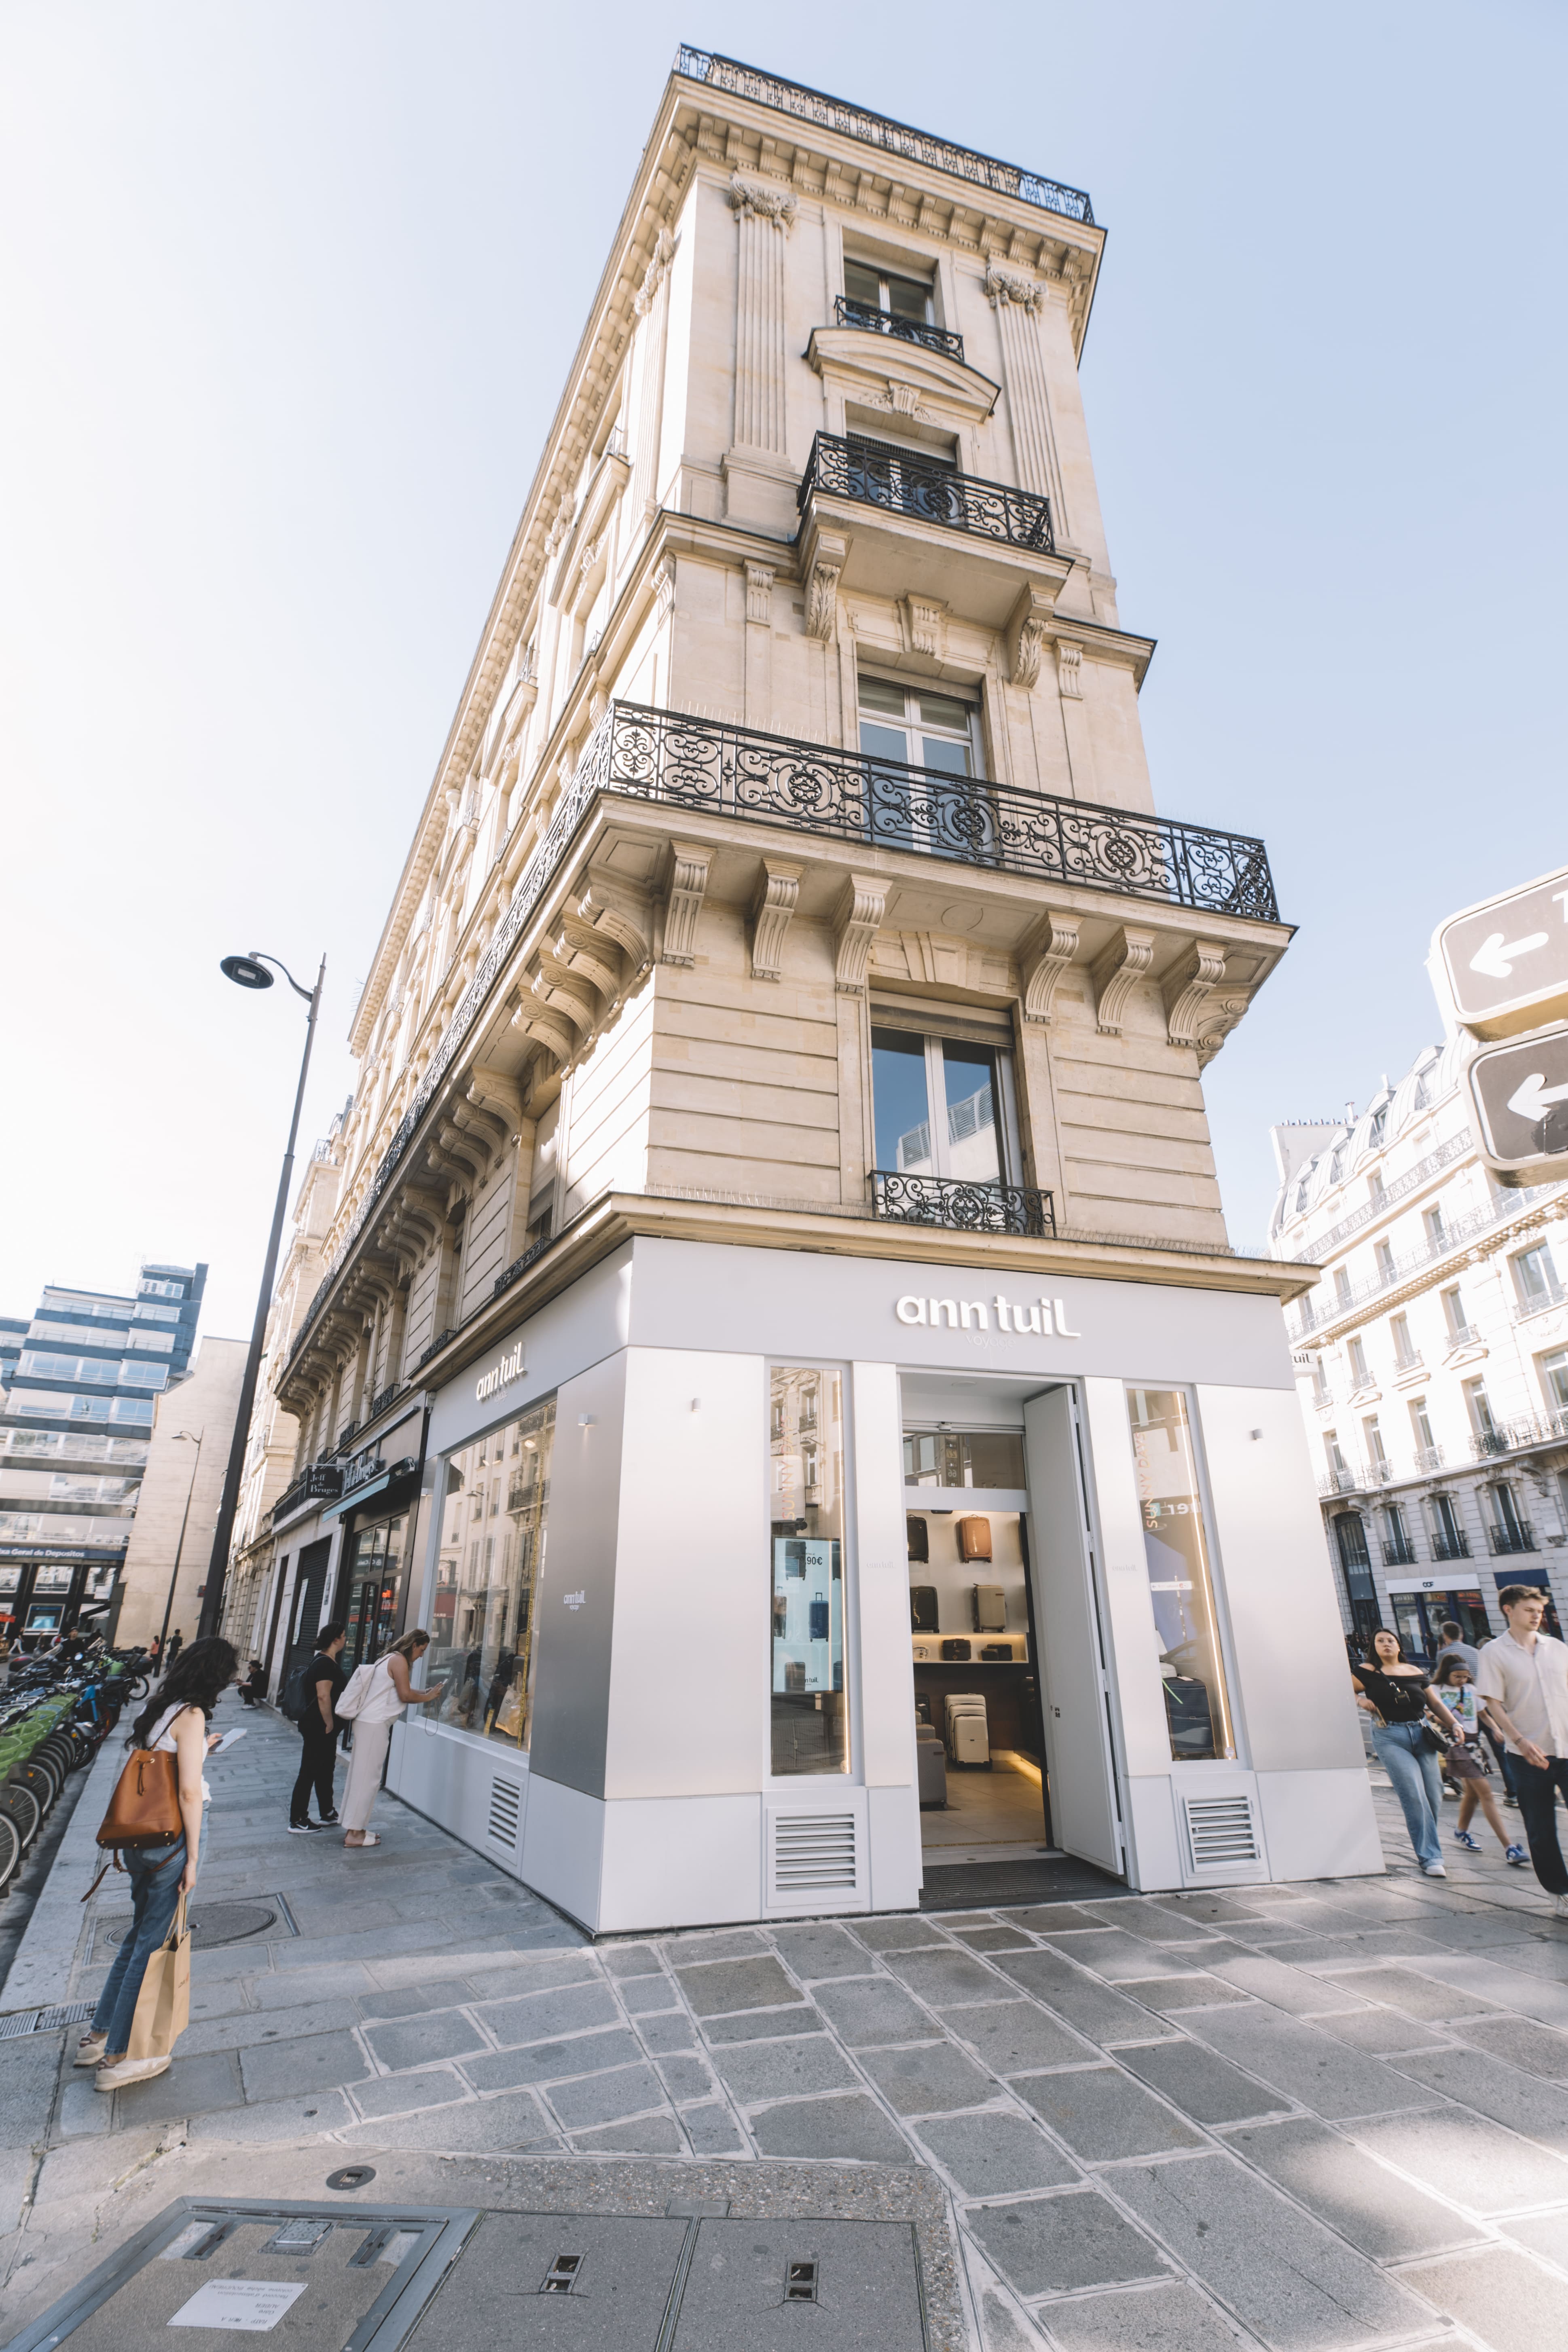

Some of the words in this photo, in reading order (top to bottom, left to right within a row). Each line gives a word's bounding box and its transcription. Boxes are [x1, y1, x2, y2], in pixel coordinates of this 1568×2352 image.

[896, 1295, 988, 1330] ann
[993, 1295, 1081, 1337] tuil
[965, 1335, 1016, 1351] voyage
[476, 1367, 499, 1401] ann
[781, 1415, 794, 1454] DAYS
[1135, 1432, 1150, 1468] DAYS
[310, 1474, 326, 1482] Jeff
[310, 1484, 339, 1494] Bruges
[781, 1461, 795, 1521] SUNNY
[1139, 1474, 1158, 1528] SUNNY
[45, 1550, 85, 1558] Depositos
[564, 1595, 575, 1604] ann
